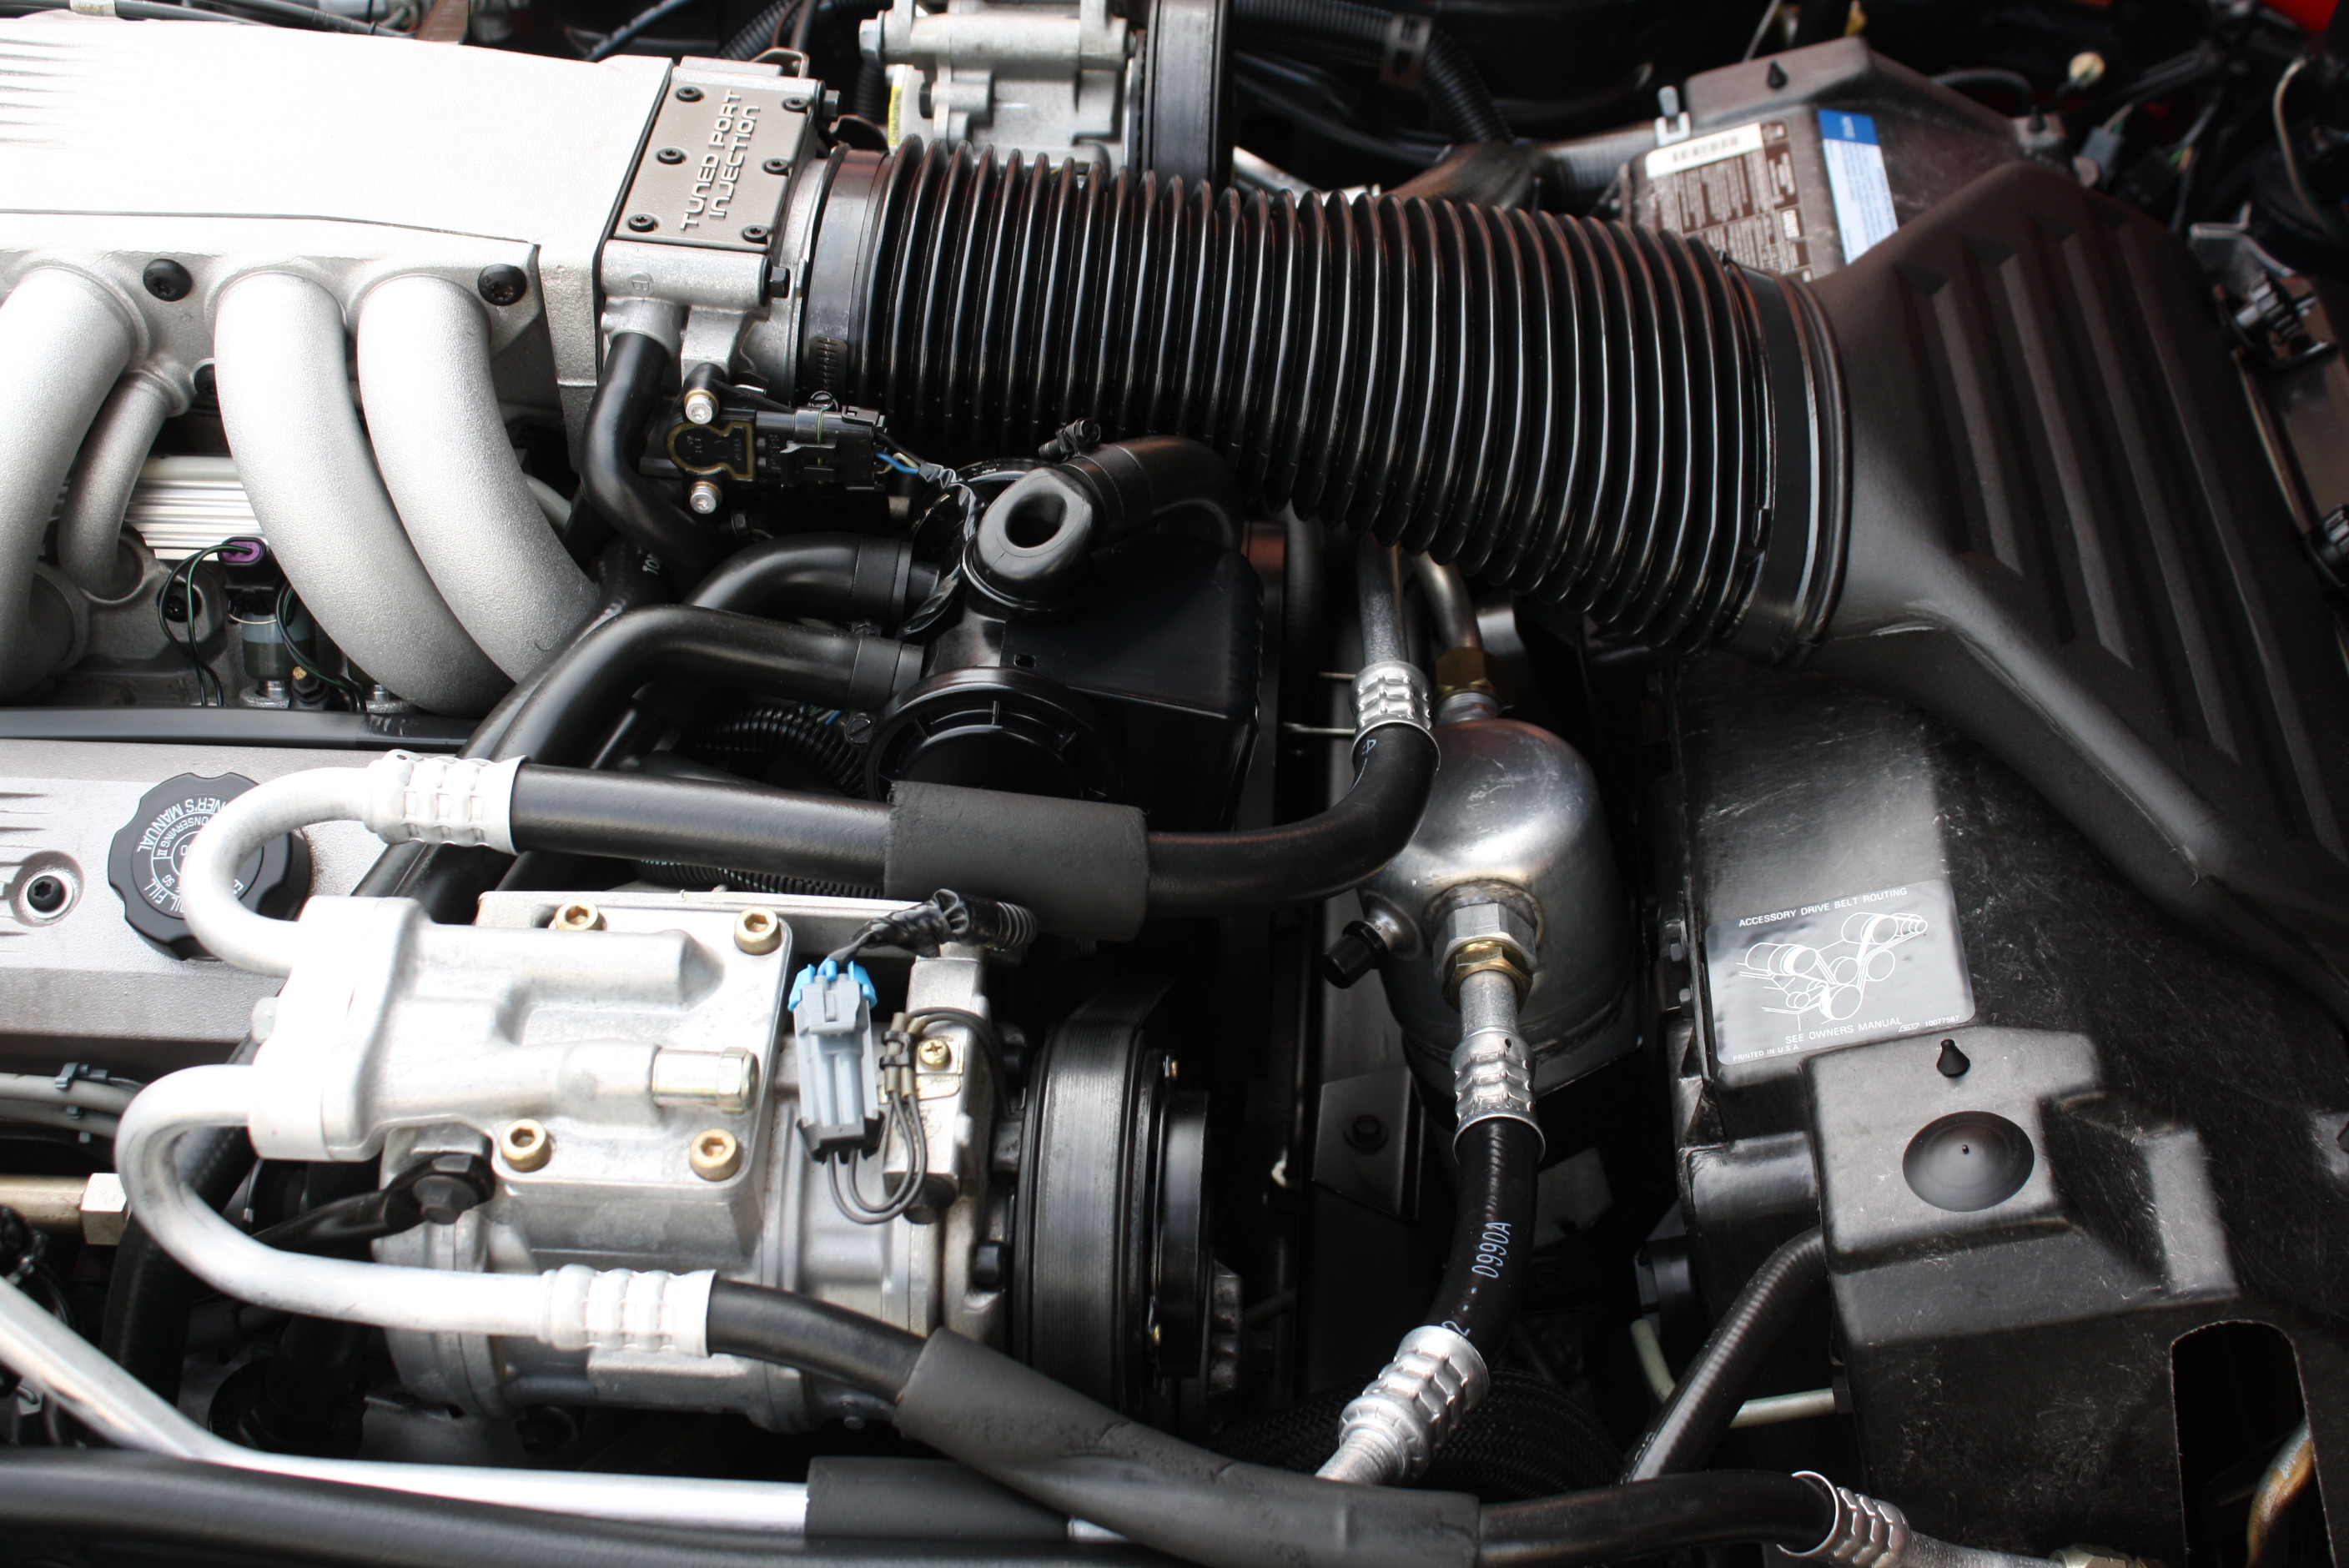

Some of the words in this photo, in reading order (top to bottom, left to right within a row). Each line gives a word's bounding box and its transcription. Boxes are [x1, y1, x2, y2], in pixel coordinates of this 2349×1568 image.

[679, 153, 720, 231] TUNED
[708, 88, 742, 148] PORT
[708, 105, 761, 219] INJECTION
[184, 797, 226, 813] NER'S
[136, 802, 184, 852] MANUAL
[160, 816, 209, 848] ONSERVING
[143, 877, 169, 905] FILL
[1738, 909, 1797, 927] ACCESSORY
[1800, 902, 1830, 916] DRIVE
[1833, 897, 1859, 909] BELT
[1863, 887, 1908, 903] ROUTING
[1785, 1033, 1804, 1044] SEE
[1808, 1024, 1854, 1040] OWNERS
[1858, 1017, 1903, 1032] MANUAL
[1733, 1049, 1764, 1062] PRINTED
